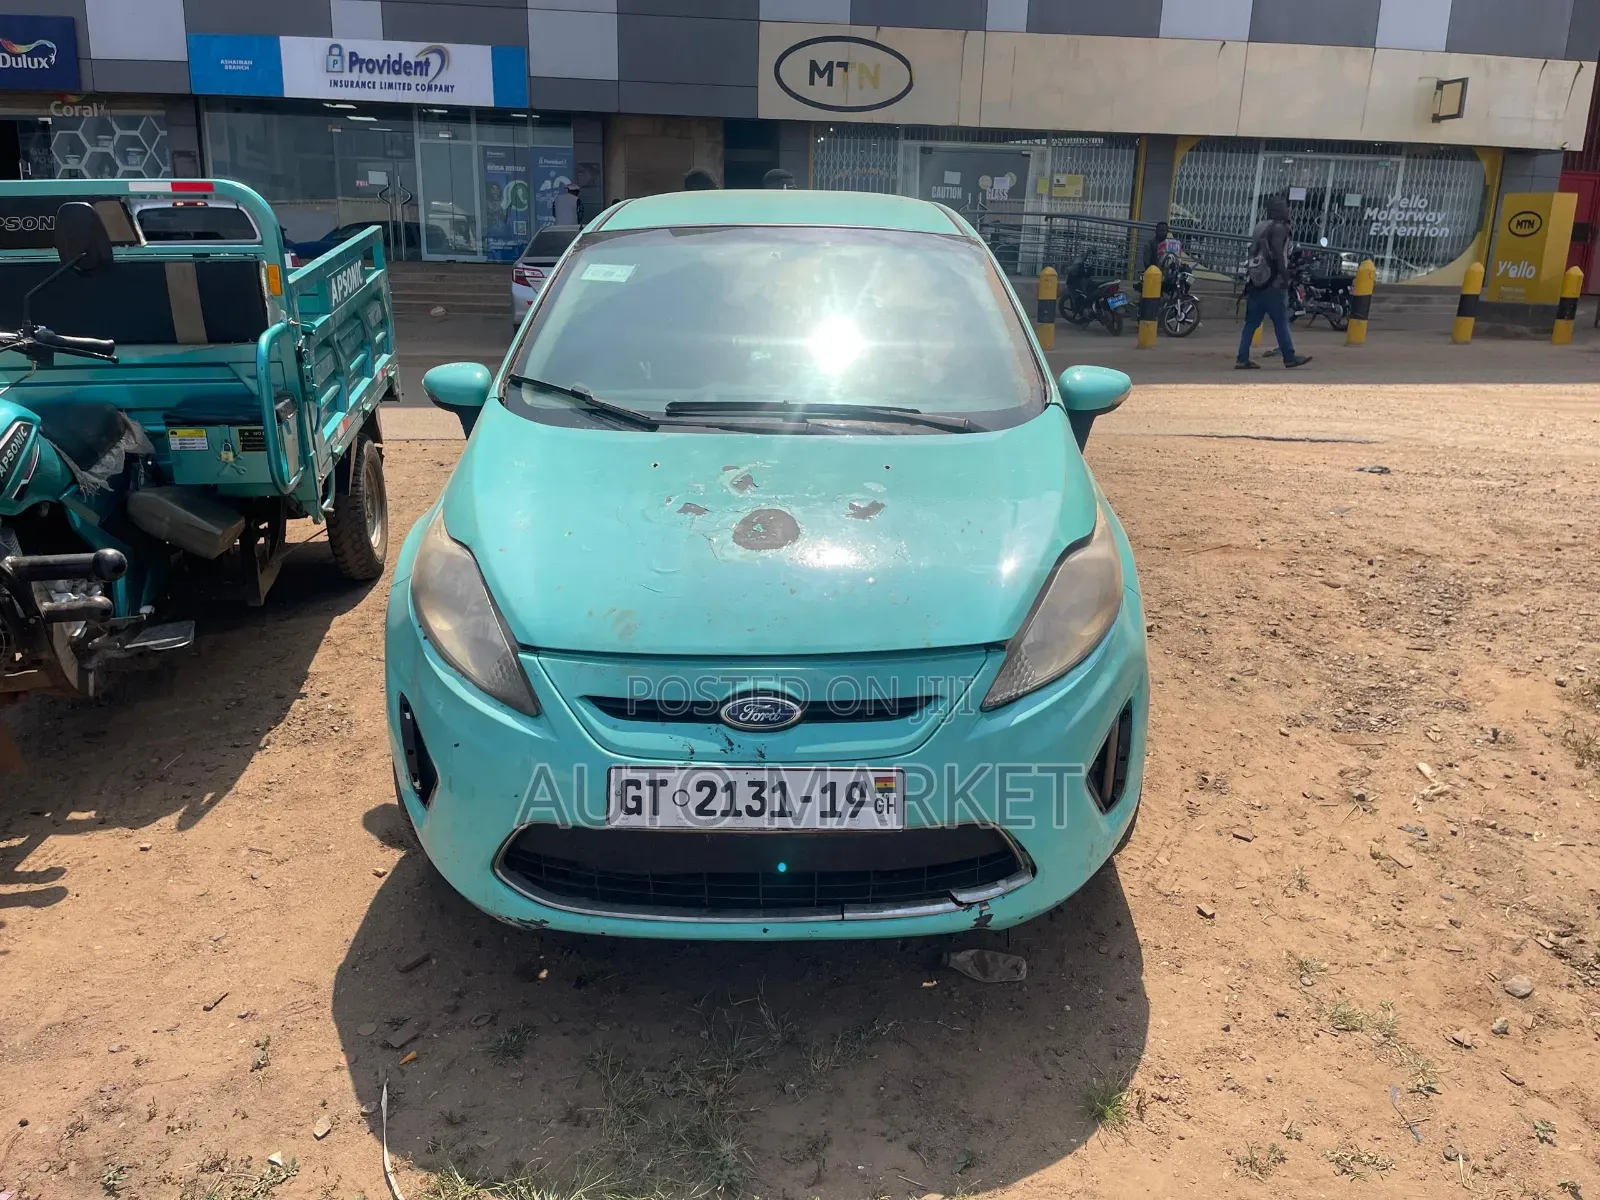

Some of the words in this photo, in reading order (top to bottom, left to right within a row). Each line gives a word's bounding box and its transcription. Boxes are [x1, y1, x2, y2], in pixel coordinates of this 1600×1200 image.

[0, 53, 50, 69] Dulux
[348, 51, 431, 77] Provident
[808, 59, 881, 90] MTN
[329, 79, 376, 90] INSURANCE
[380, 81, 412, 91] LIMITED
[415, 83, 455, 93] COMPANY
[50, 101, 98, 117] Coral
[931, 186, 962, 199] CAUTION
[986, 188, 1009, 200] GLASS
[1363, 207, 1446, 225] Motorway
[1515, 219, 1535, 230] MTN
[1369, 222, 1449, 238] Extention
[331, 259, 364, 307] APSONIC
[738, 704, 781, 722] Ford
[620, 779, 668, 817] GT
[694, 780, 868, 818] 2131-19
[873, 797, 897, 815] GH
